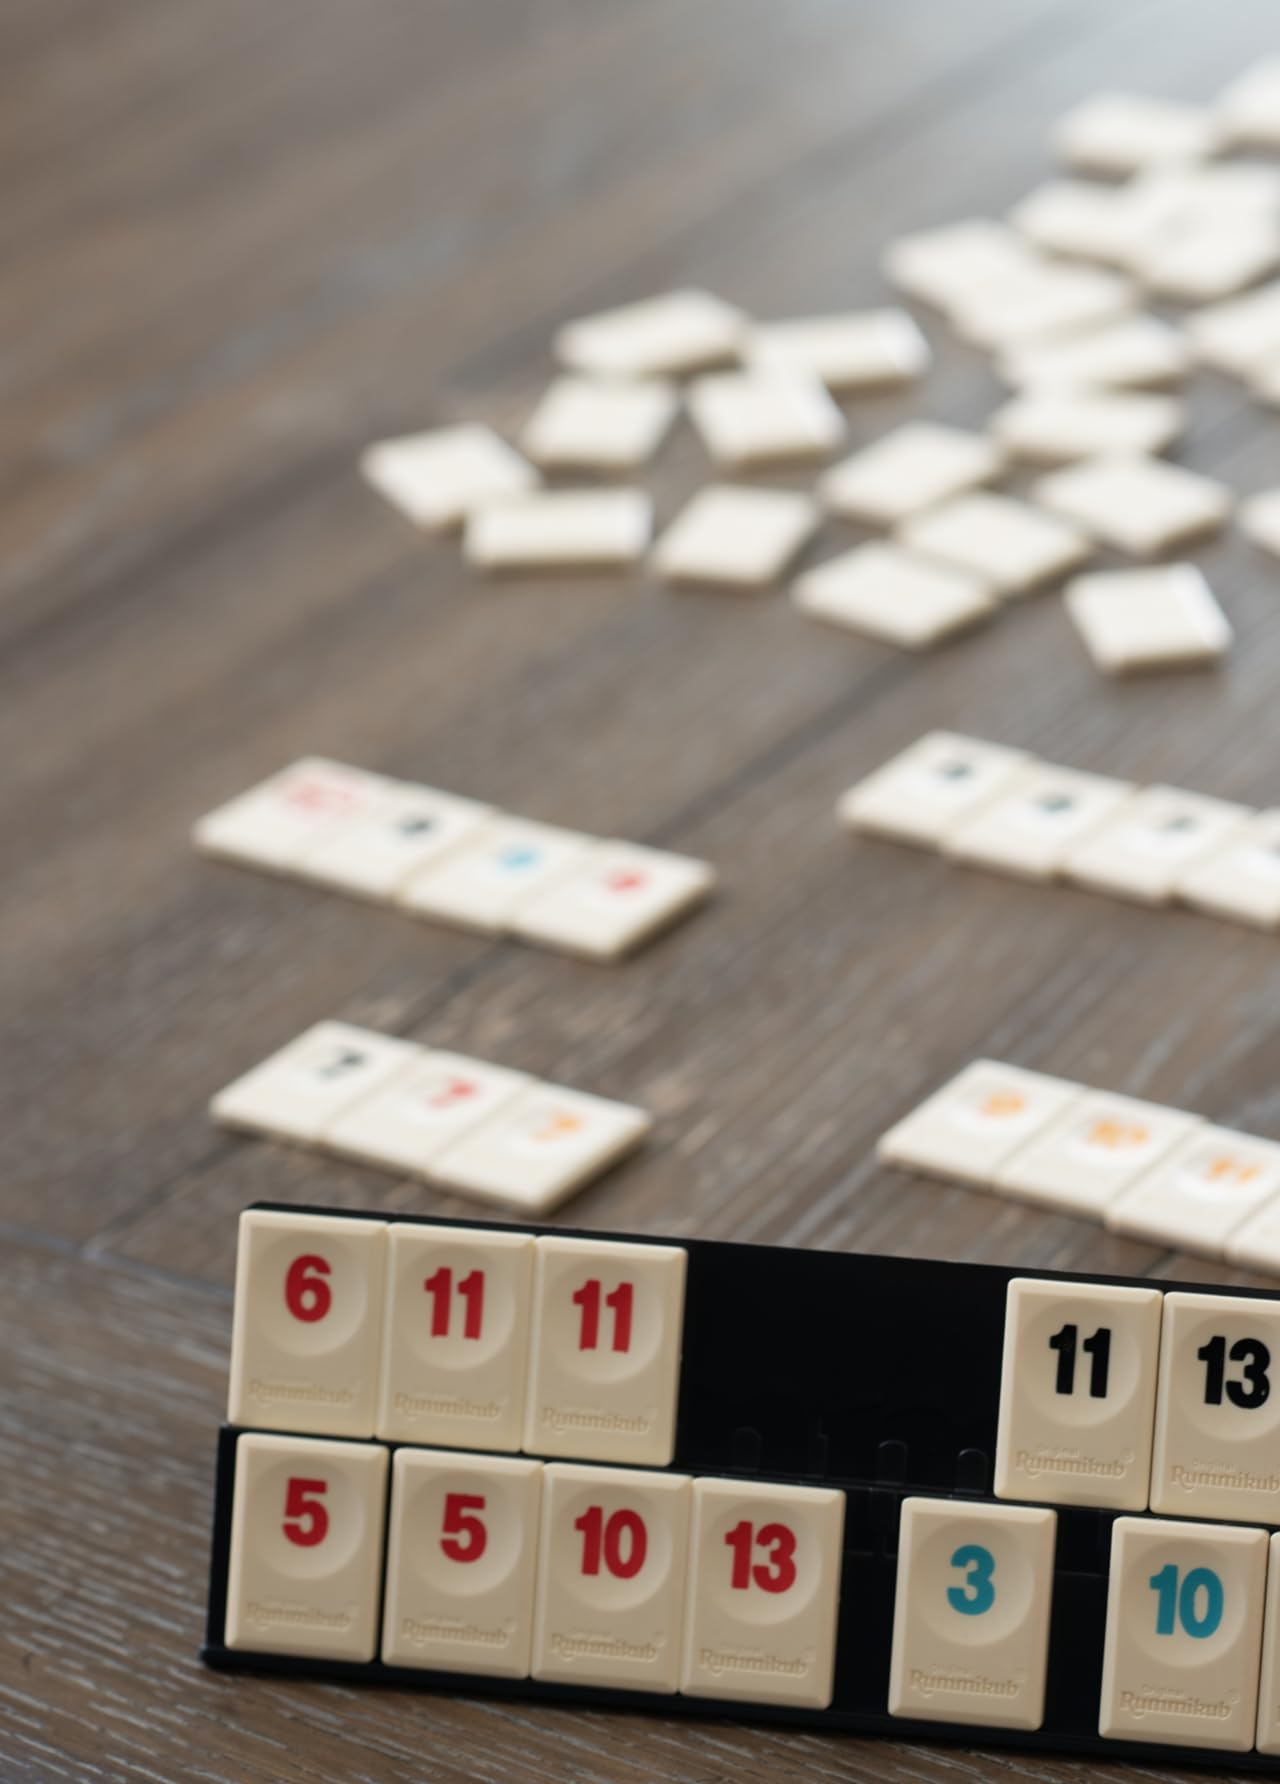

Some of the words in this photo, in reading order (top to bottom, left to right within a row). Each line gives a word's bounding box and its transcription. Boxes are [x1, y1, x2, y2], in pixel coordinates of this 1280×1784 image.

[285, 1254, 332, 1323] 6
[424, 1267, 485, 1340] 11
[572, 1279, 634, 1353] 11
[1048, 1323, 1112, 1399] 11
[1196, 1334, 1272, 1410] 13
[282, 1477, 329, 1547] 5
[440, 1492, 487, 1563] 5
[574, 1506, 648, 1579] 10
[724, 1520, 797, 1594] 13
[946, 1545, 996, 1615] 3
[1150, 1564, 1224, 1639] 10
